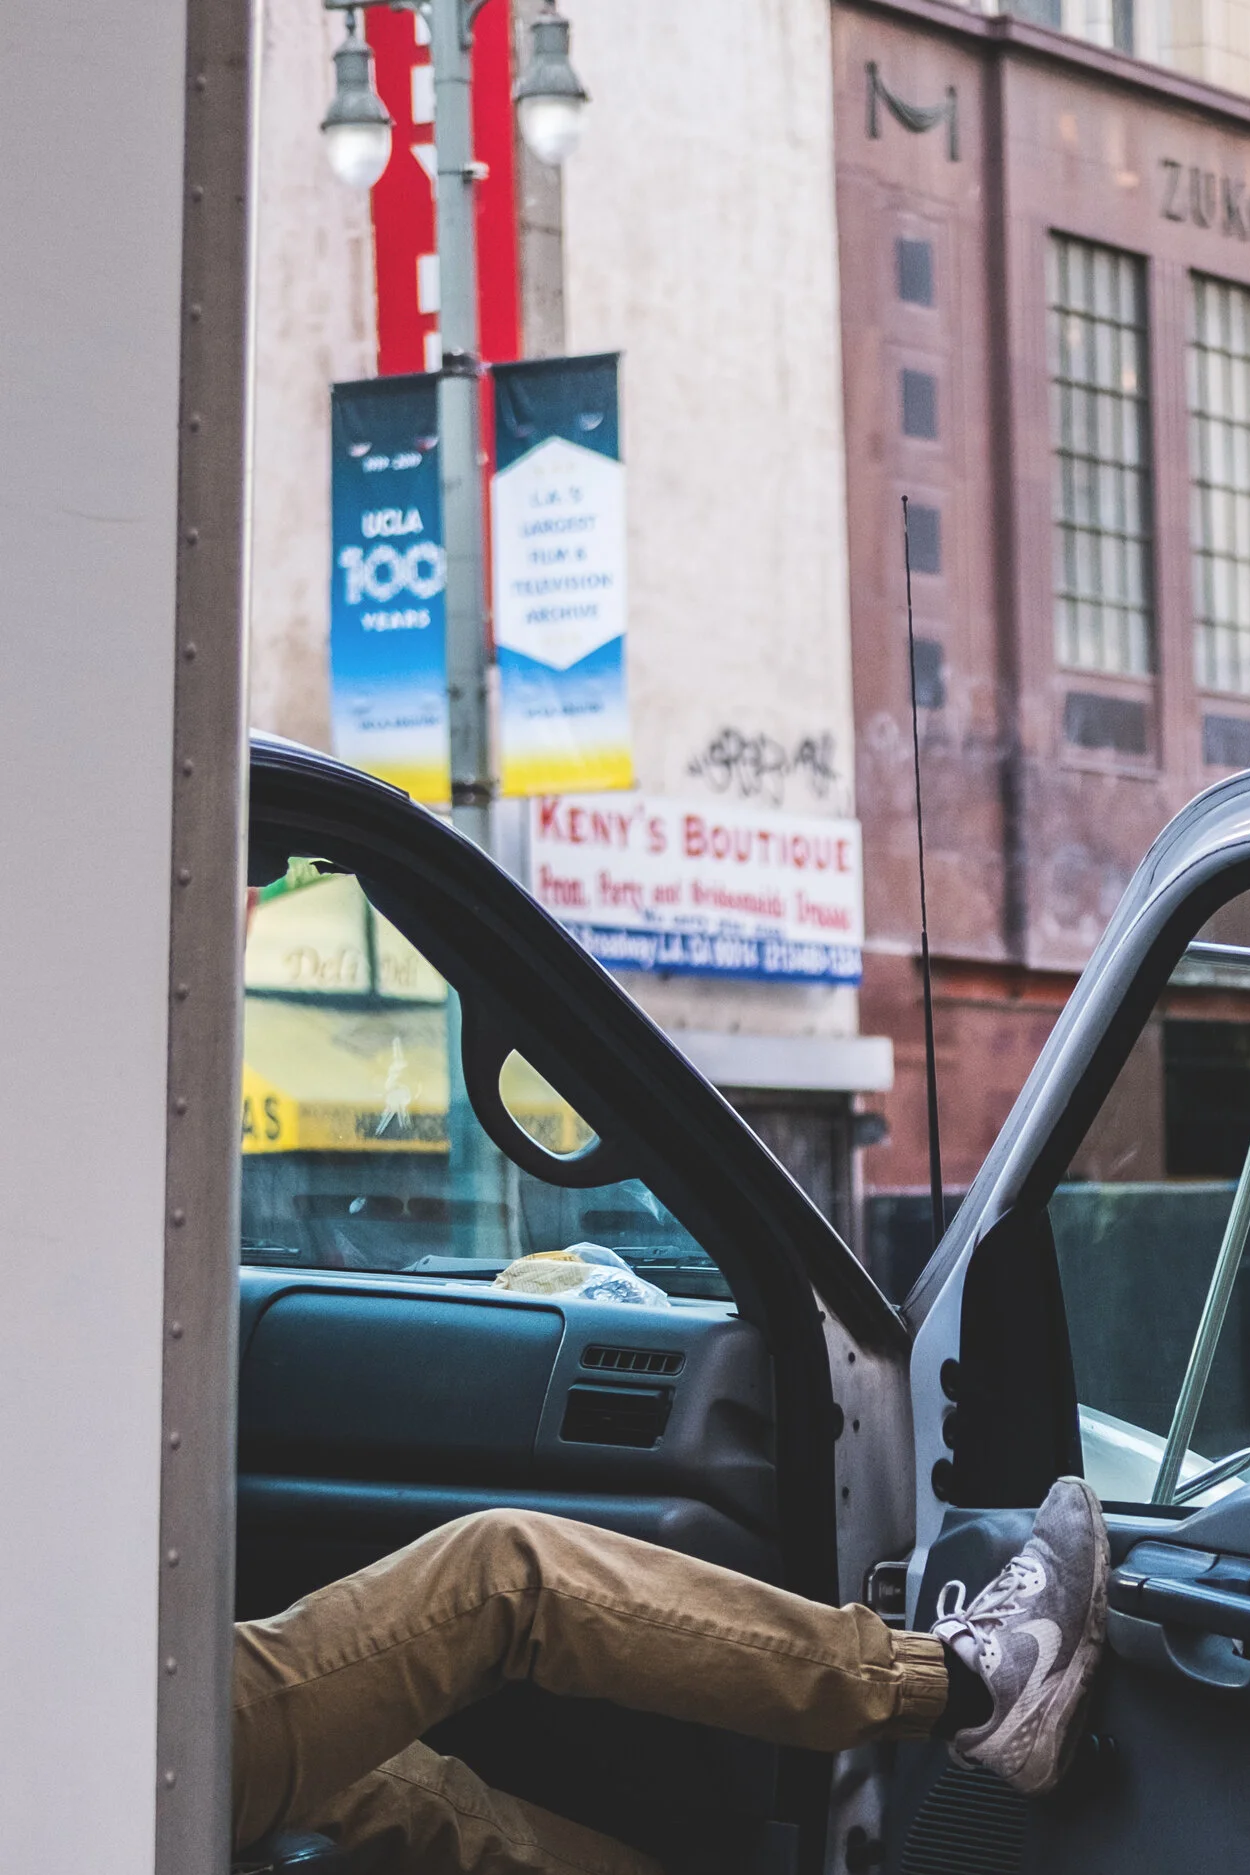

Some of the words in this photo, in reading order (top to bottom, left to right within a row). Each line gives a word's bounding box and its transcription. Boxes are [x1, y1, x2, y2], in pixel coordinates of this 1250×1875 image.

[361, 508, 424, 538] UCLA
[337, 541, 446, 605] 100
[360, 609, 431, 632] YEARS
